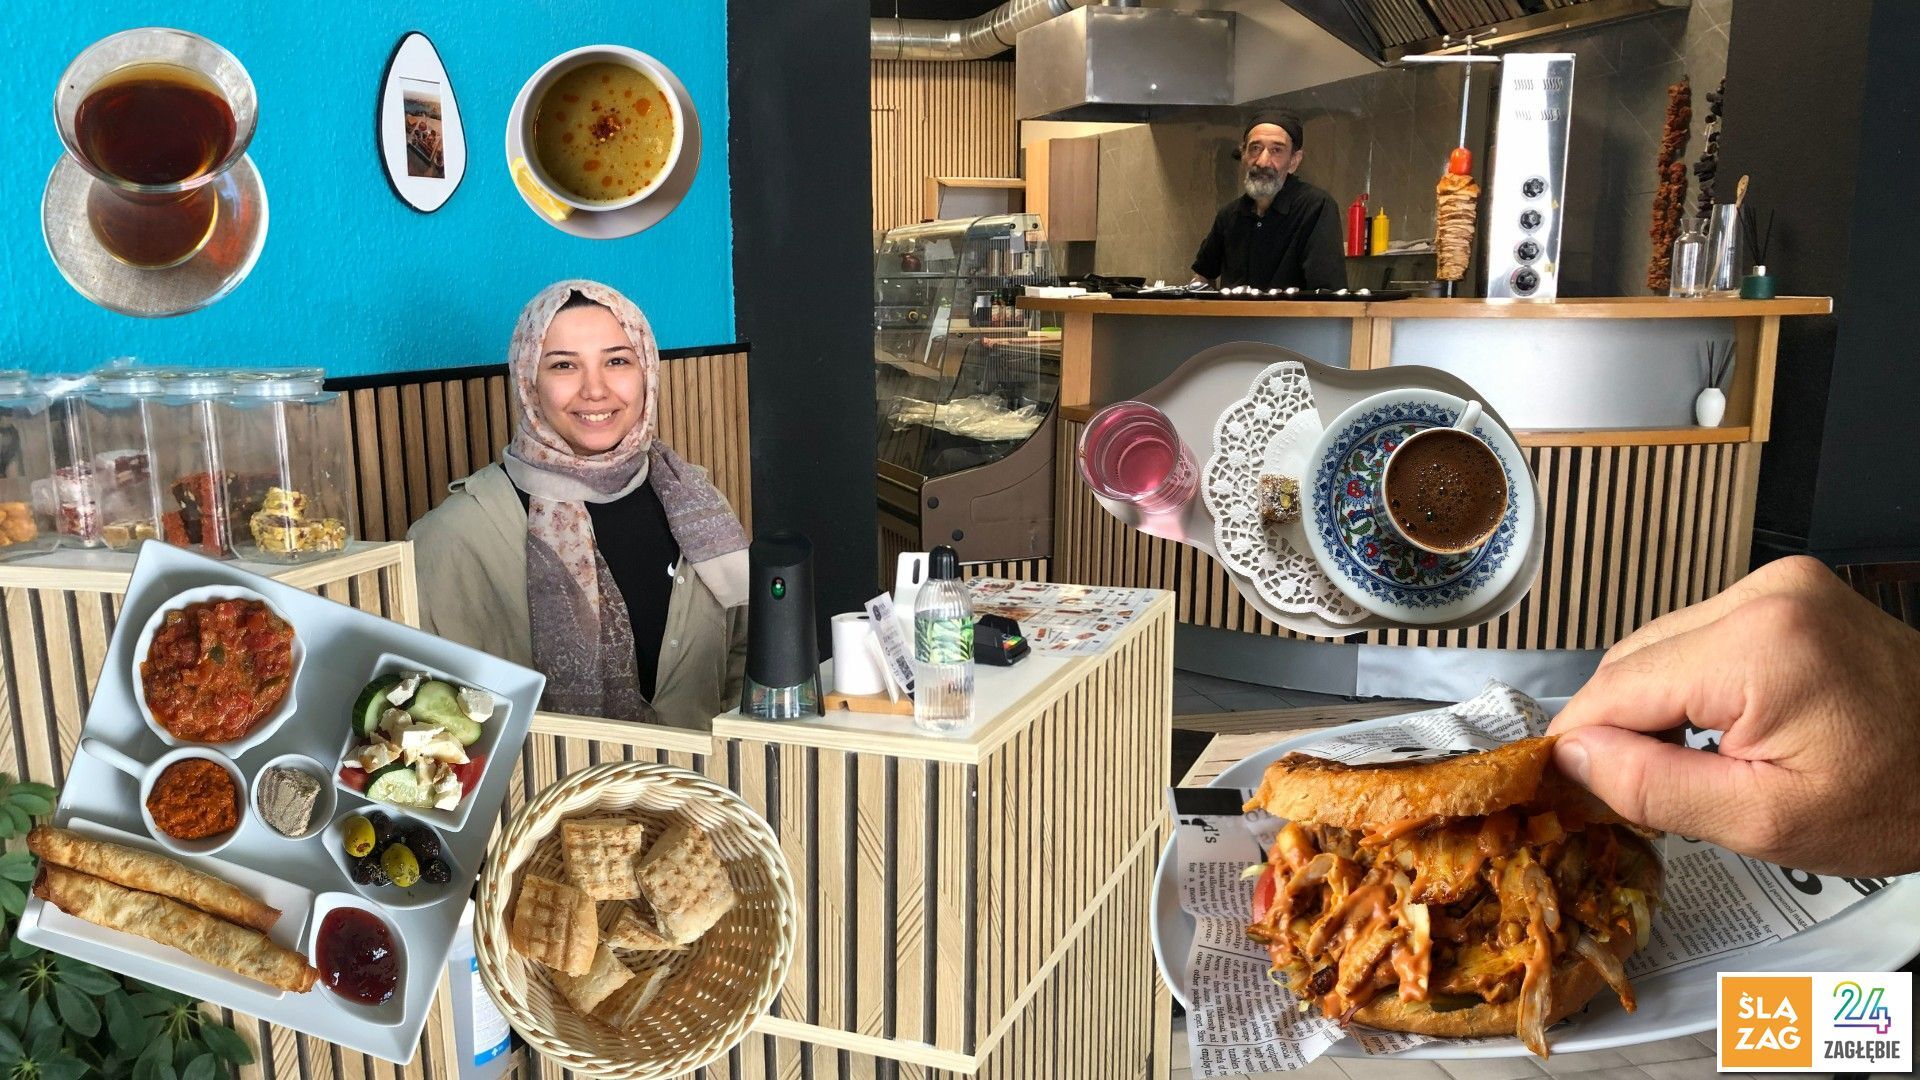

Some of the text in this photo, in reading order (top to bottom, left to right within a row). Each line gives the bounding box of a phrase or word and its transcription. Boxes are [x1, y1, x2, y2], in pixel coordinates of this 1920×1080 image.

[1481, 716, 1503, 729] quality
[1511, 727, 1522, 736] the
[1209, 862, 1217, 873] has
[1218, 861, 1226, 887] Ireland
[1228, 861, 1236, 877] ald's
[1199, 880, 1207, 896] with
[1209, 875, 1217, 901] allowed
[1705, 888, 1722, 909] Design
[1706, 874, 1721, 893] design
[1719, 892, 1728, 904] was
[1726, 904, 1742, 922] based
[1738, 922, 1746, 930] on
[1744, 930, 1754, 940] the
[1769, 887, 1796, 914] personnel
[1691, 912, 1701, 923] the
[1704, 902, 1723, 925] industry
[1745, 901, 1763, 924] looking
[1762, 923, 1772, 933] for
[1684, 933, 1702, 955] project
[1214, 955, 1222, 970] bers
[1223, 957, 1231, 979] tition's
[1233, 959, 1239, 967] of
[1213, 980, 1221, 993] three
[1222, 982, 1230, 991] jury
[1204, 953, 1213, 970] from
[1209, 1033, 1218, 1042] and
[1192, 988, 1201, 1011] packaging
[1197, 1030, 1205, 1042] Since
[1199, 1048, 1212, 1068] employ
[1214, 1048, 1224, 1063] levels
[1228, 1048, 1238, 1069] tumblers
